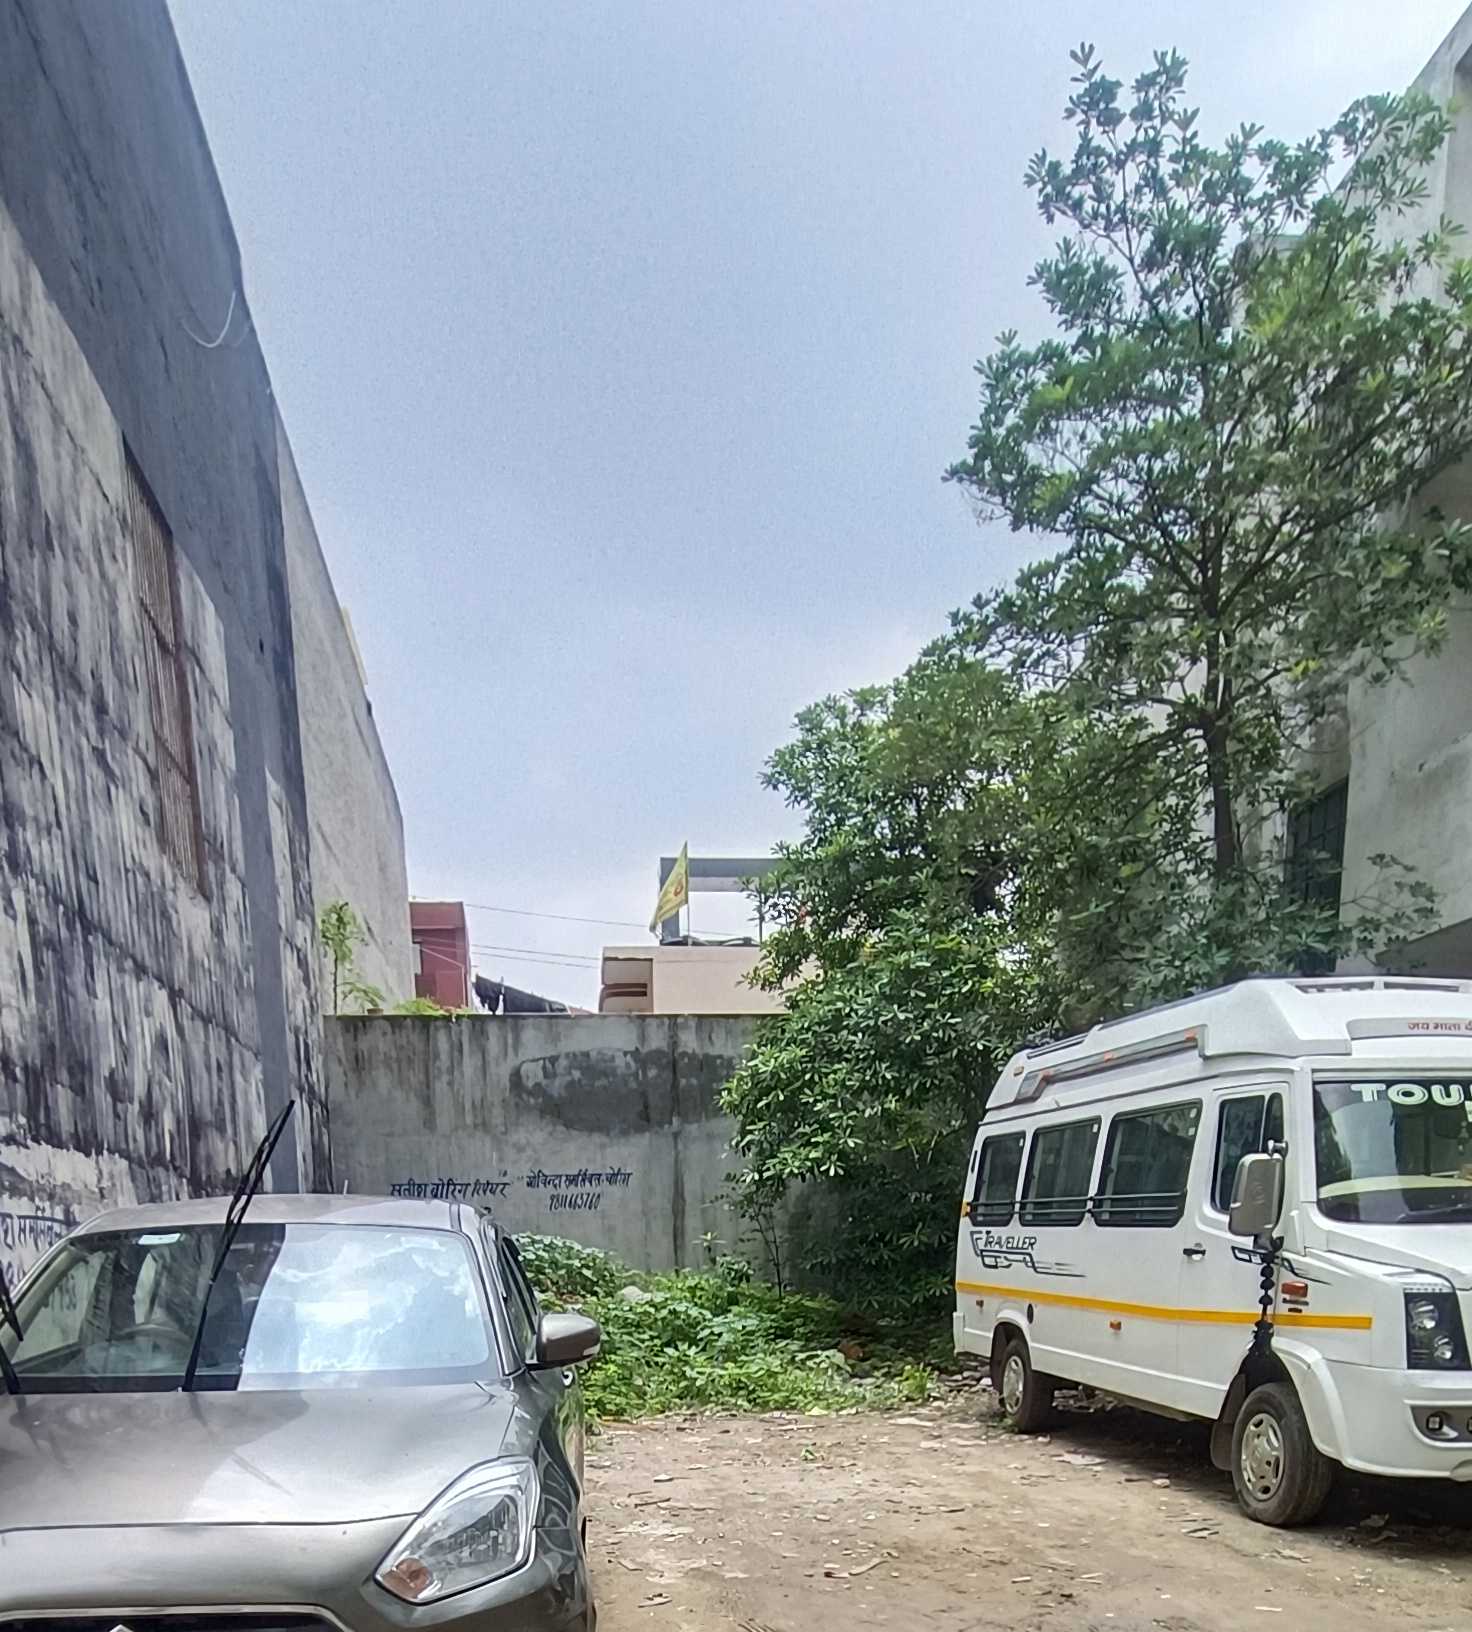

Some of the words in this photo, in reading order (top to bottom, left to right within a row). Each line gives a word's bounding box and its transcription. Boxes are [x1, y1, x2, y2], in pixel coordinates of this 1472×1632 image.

[1407, 1022, 1429, 1031] जय
[1433, 1022, 1461, 1031] माता
[1351, 1083, 1472, 1106] TOU
[984, 1230, 1037, 1250] TRAVELLER
